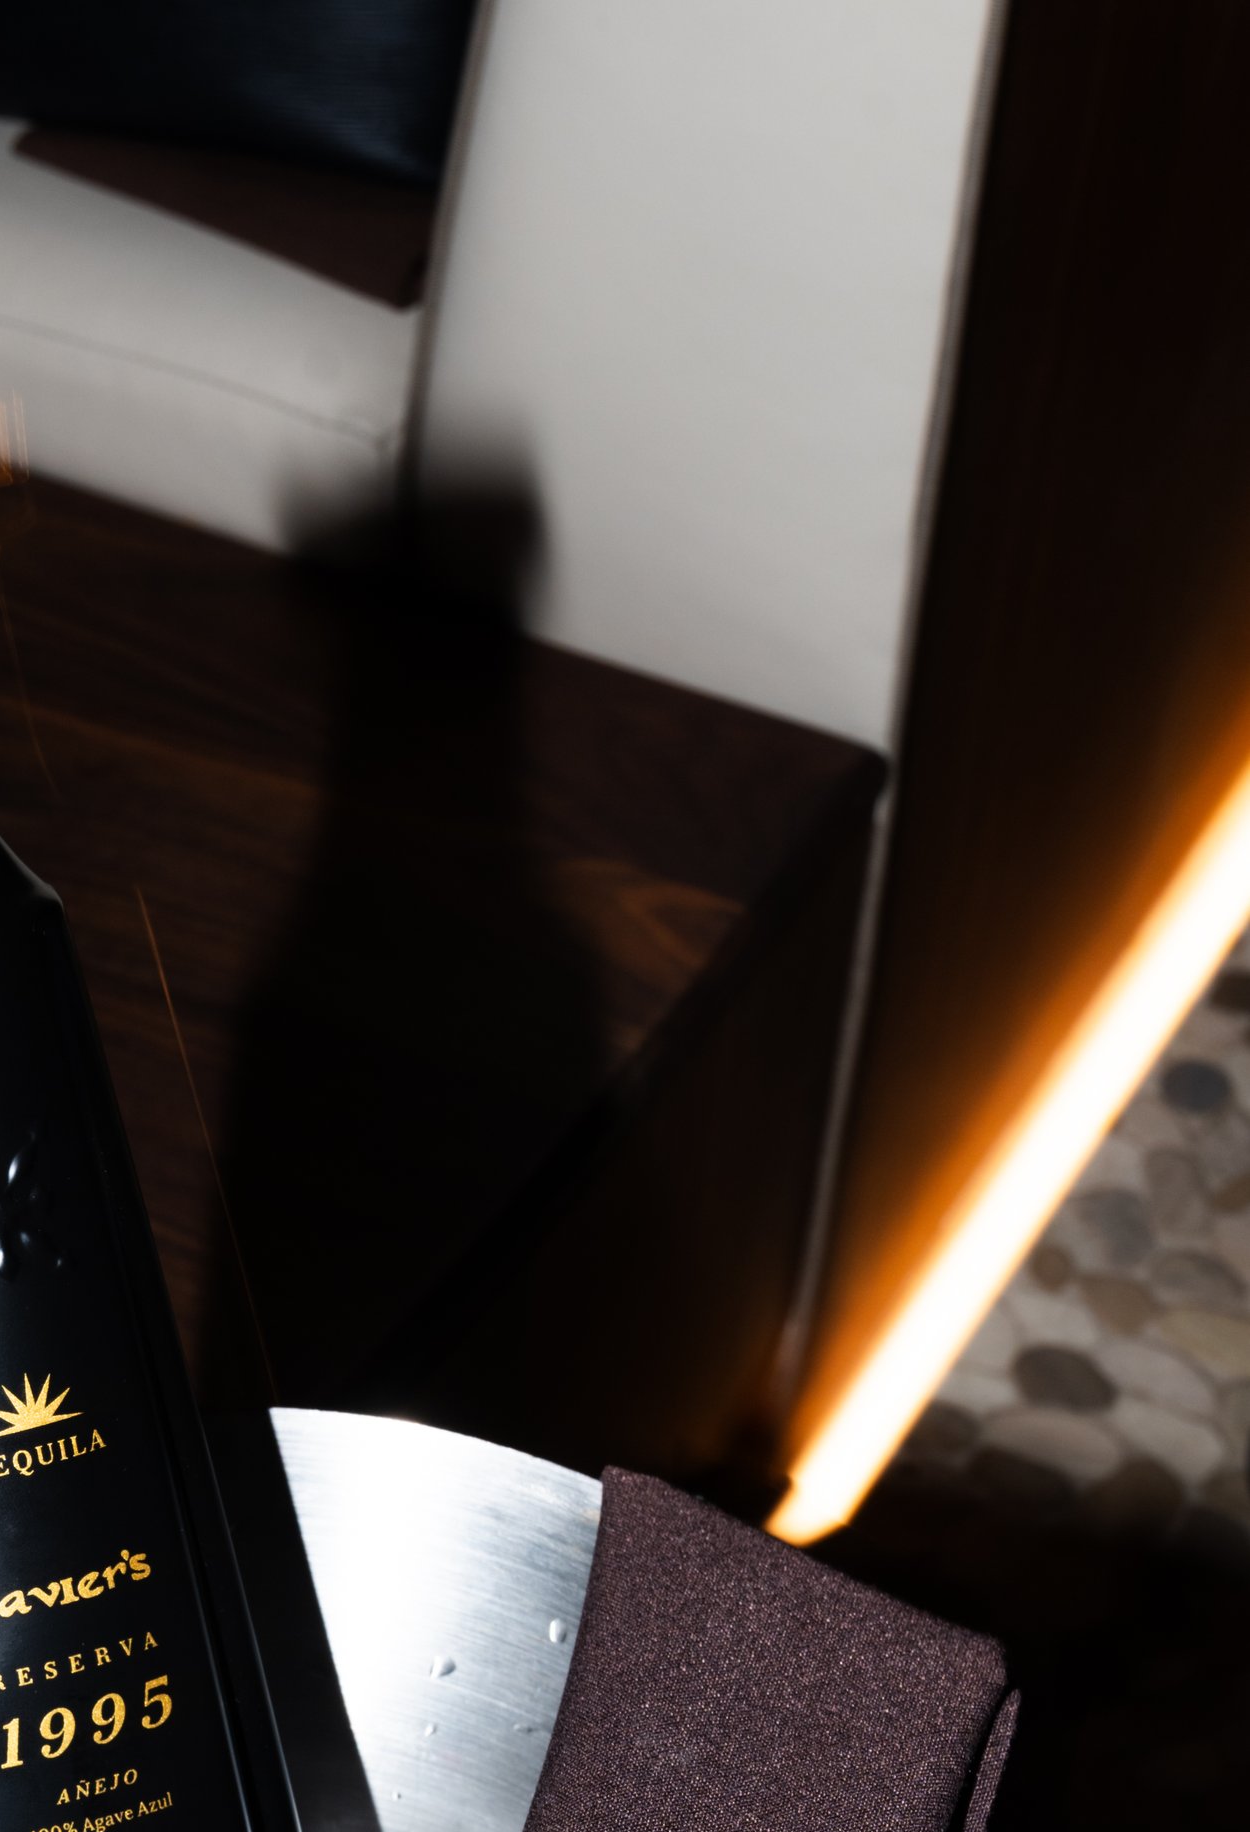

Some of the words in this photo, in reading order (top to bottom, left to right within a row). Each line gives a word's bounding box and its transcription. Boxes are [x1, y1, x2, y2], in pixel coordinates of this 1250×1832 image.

[0, 1674, 173, 1770] 1995
[57, 1768, 139, 1805] AÑEJO
[137, 1791, 174, 1816] Azul
